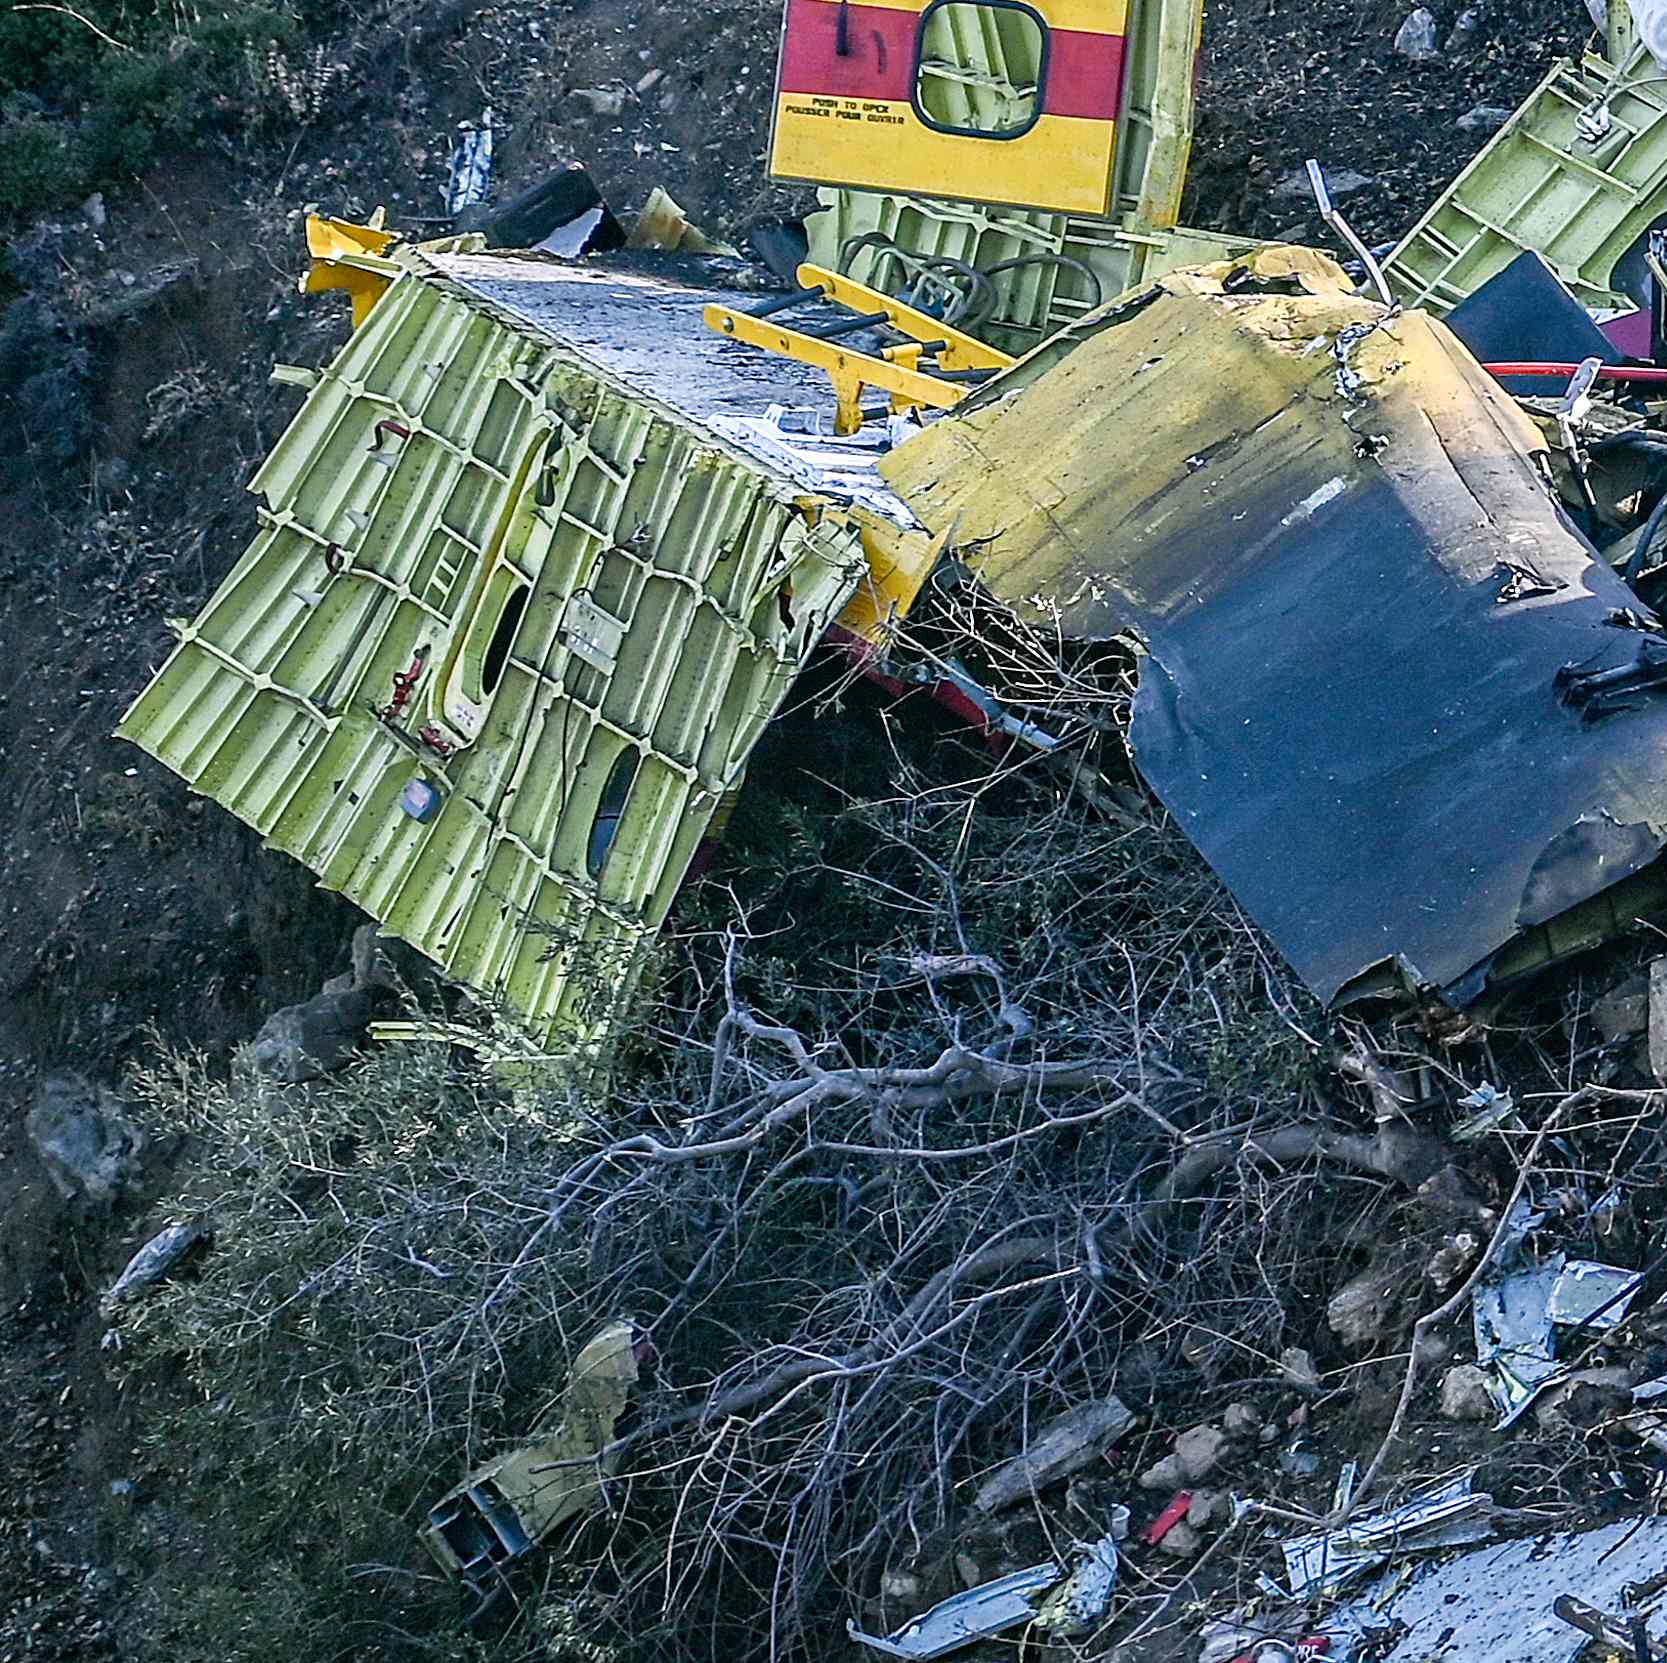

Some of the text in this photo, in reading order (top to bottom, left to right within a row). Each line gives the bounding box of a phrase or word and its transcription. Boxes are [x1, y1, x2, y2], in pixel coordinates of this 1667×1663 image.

[812, 98, 889, 113] PUSH TO OPEN
[835, 110, 861, 120] POUR
[867, 114, 905, 125] OUVRIR
